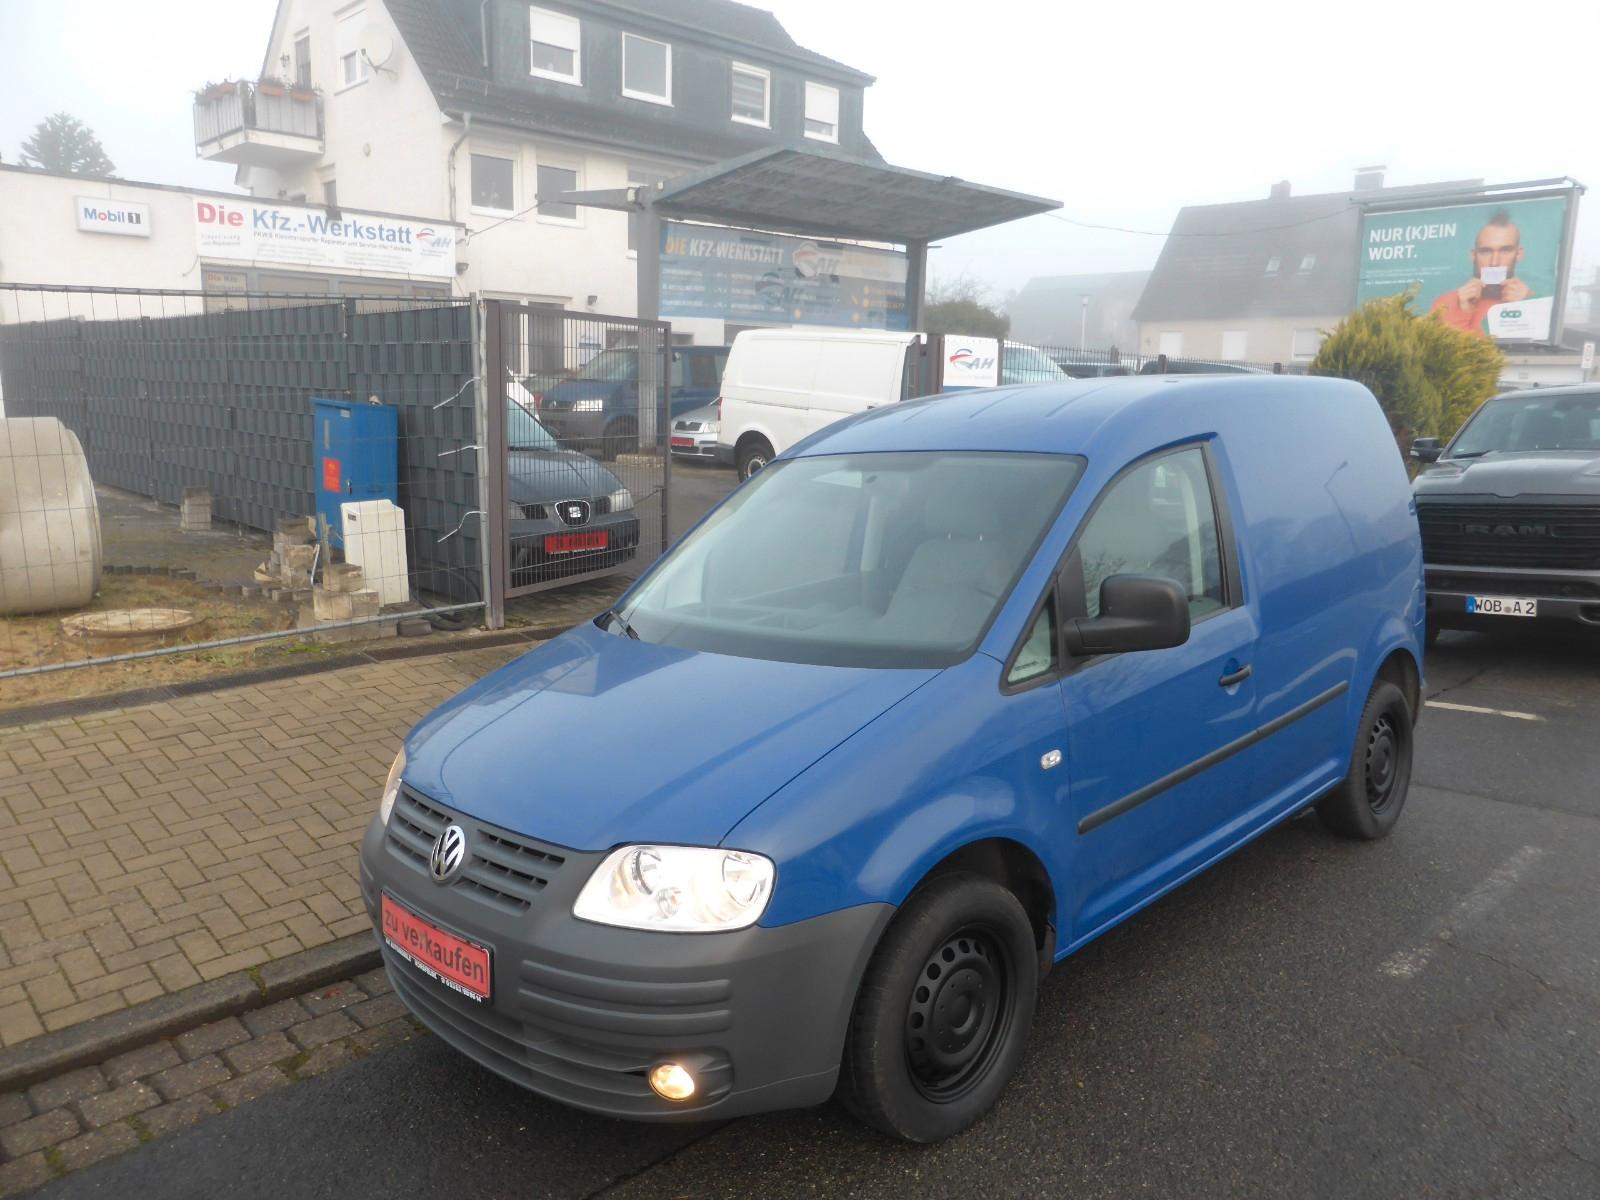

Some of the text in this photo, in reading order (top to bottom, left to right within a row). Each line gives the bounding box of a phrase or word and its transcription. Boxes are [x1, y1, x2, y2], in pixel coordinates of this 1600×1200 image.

[84, 207, 125, 223] Mobil
[197, 201, 411, 244] Die Kfz.-Werkstatt
[1369, 222, 1457, 243] NUR (K)EIN
[664, 235, 784, 265] DIE KFZ-WERKSTATT
[1368, 244, 1418, 261] WORT.
[969, 357, 994, 370] AH
[1464, 524, 1547, 535] RAM
[1474, 598, 1502, 613] WOB
[1525, 602, 1536, 615] 2
[385, 910, 399, 932] zu
[402, 920, 485, 984] verkaufen
